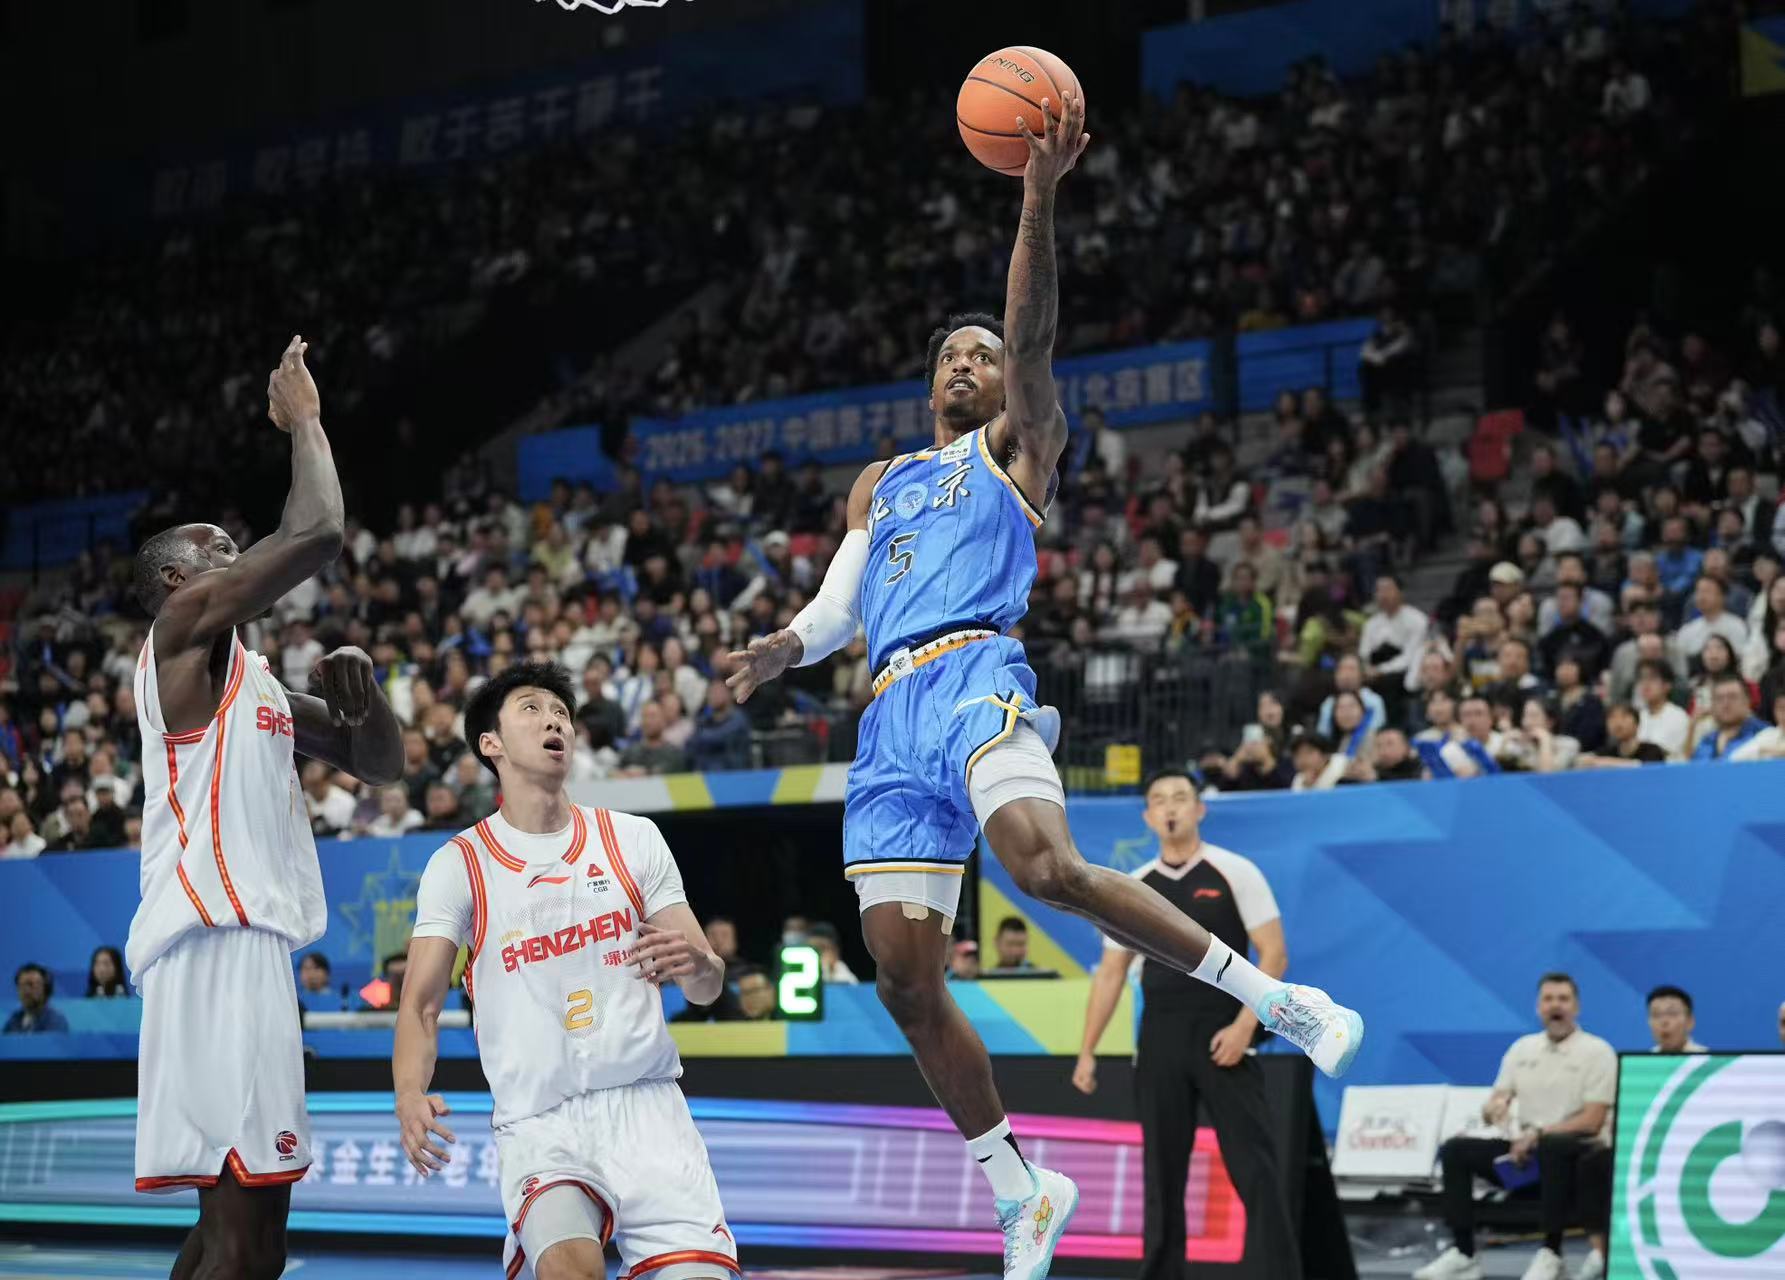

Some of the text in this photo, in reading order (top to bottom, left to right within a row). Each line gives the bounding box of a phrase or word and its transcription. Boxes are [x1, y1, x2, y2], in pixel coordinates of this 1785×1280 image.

[885, 531, 921, 586] 5
[501, 907, 633, 973] SHENZHEN
[565, 988, 594, 1031] 2
[779, 946, 820, 1014] 2
